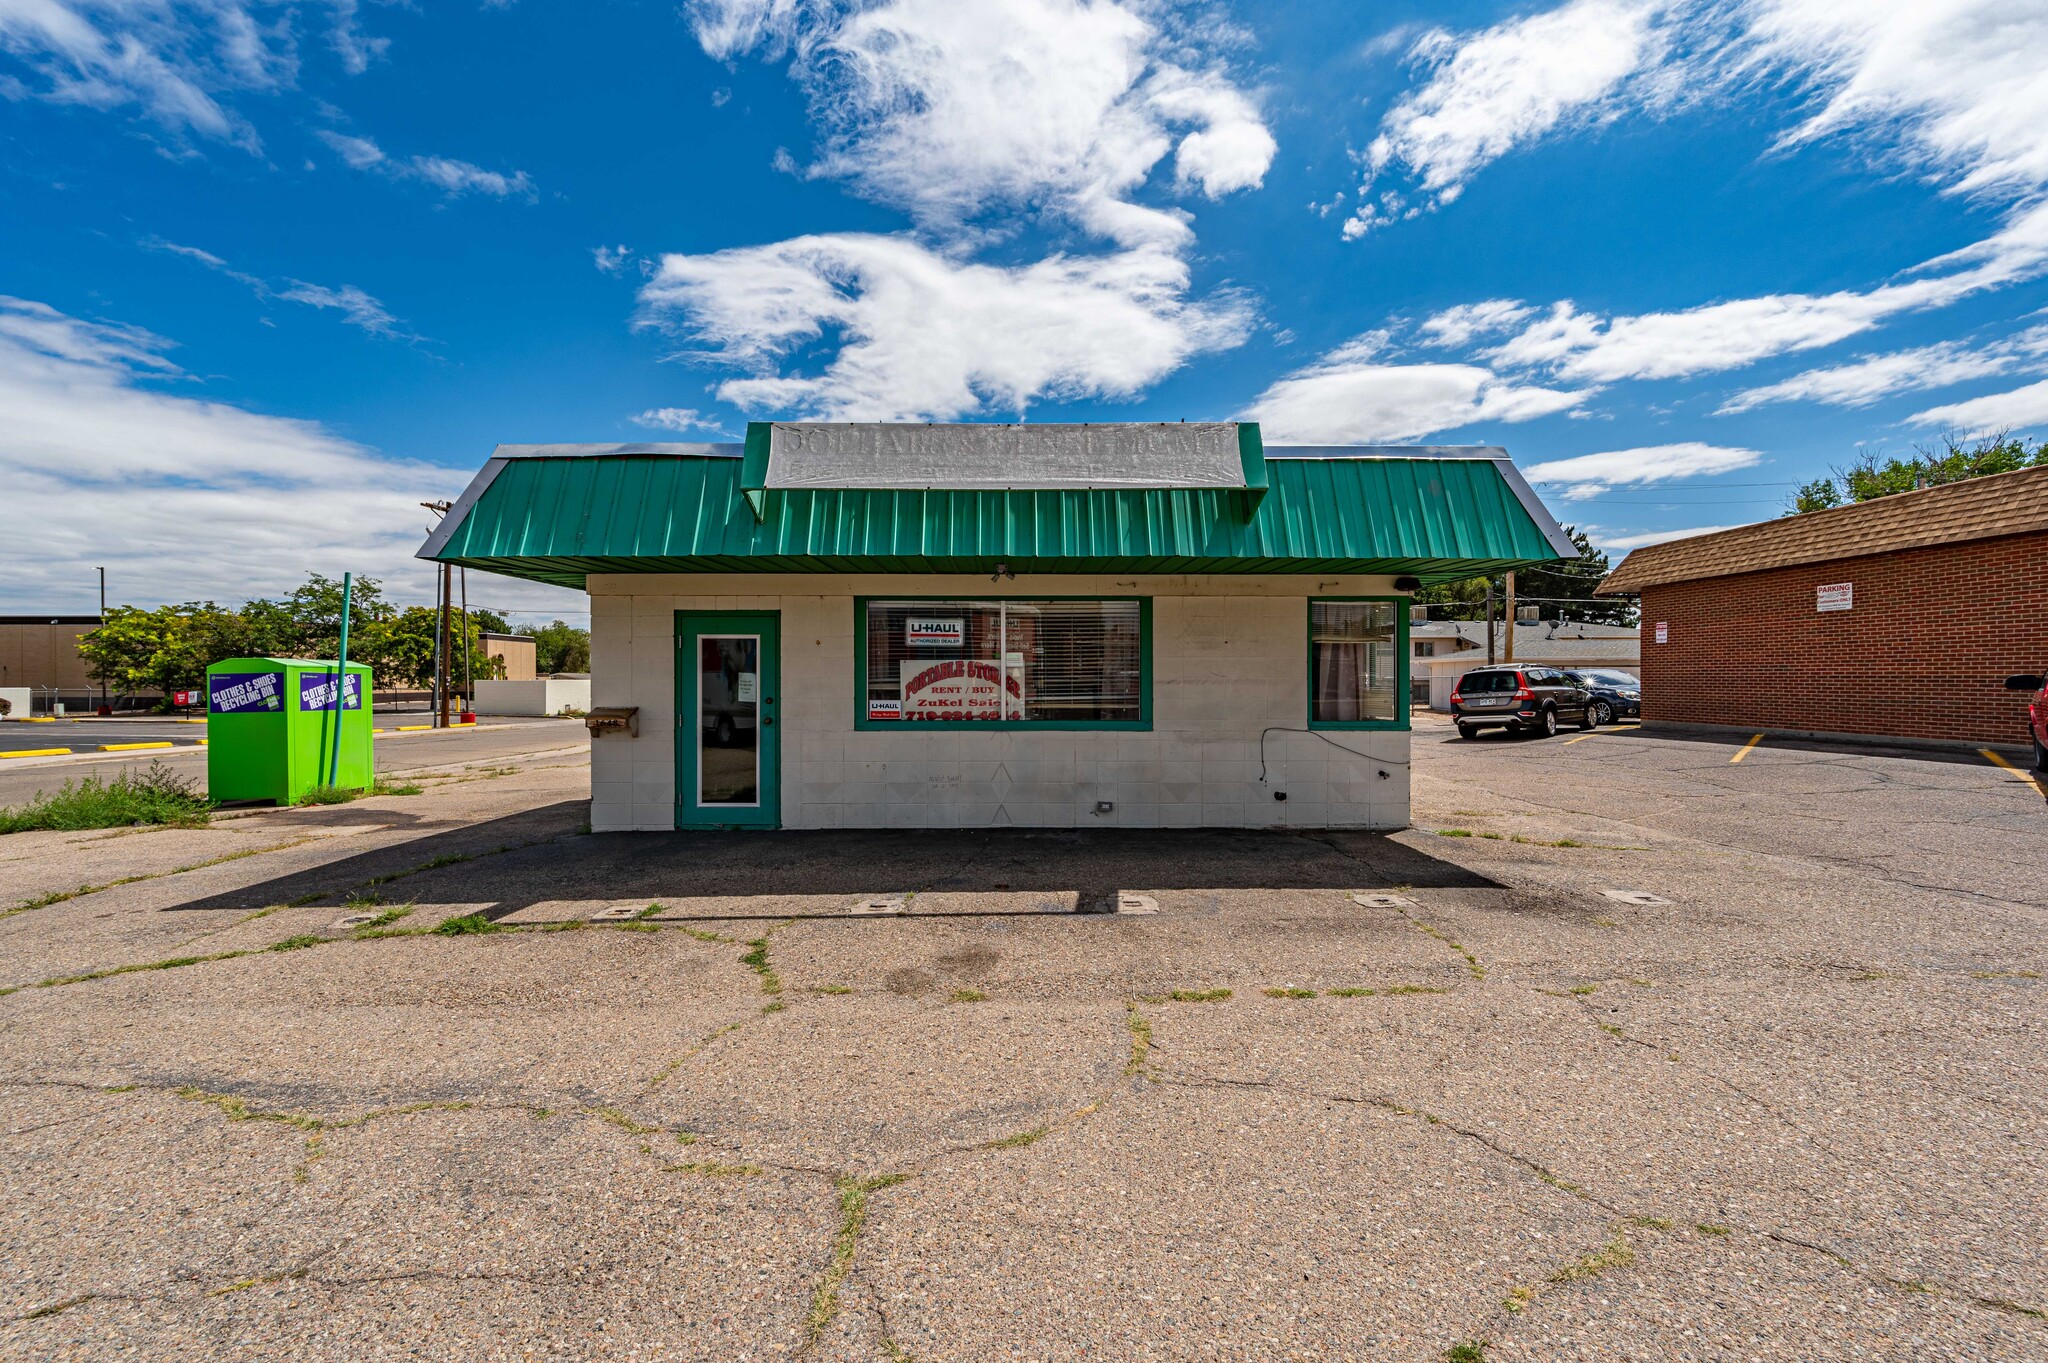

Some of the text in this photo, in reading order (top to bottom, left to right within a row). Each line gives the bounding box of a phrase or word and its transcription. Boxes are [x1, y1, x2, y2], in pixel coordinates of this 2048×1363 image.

[1818, 584, 1850, 593] PARKING
[911, 623, 959, 633] U-HAUL
[905, 660, 1020, 701] PORTABLE STORGE
[211, 673, 277, 704] CLOTHES & SHOES
[302, 683, 330, 702] CLOTHES
[330, 681, 336, 691] &
[931, 686, 962, 694] RENT
[971, 686, 995, 694] BUY
[220, 684, 275, 712] RECYCLING BIN
[968, 698, 1008, 707] Sale
